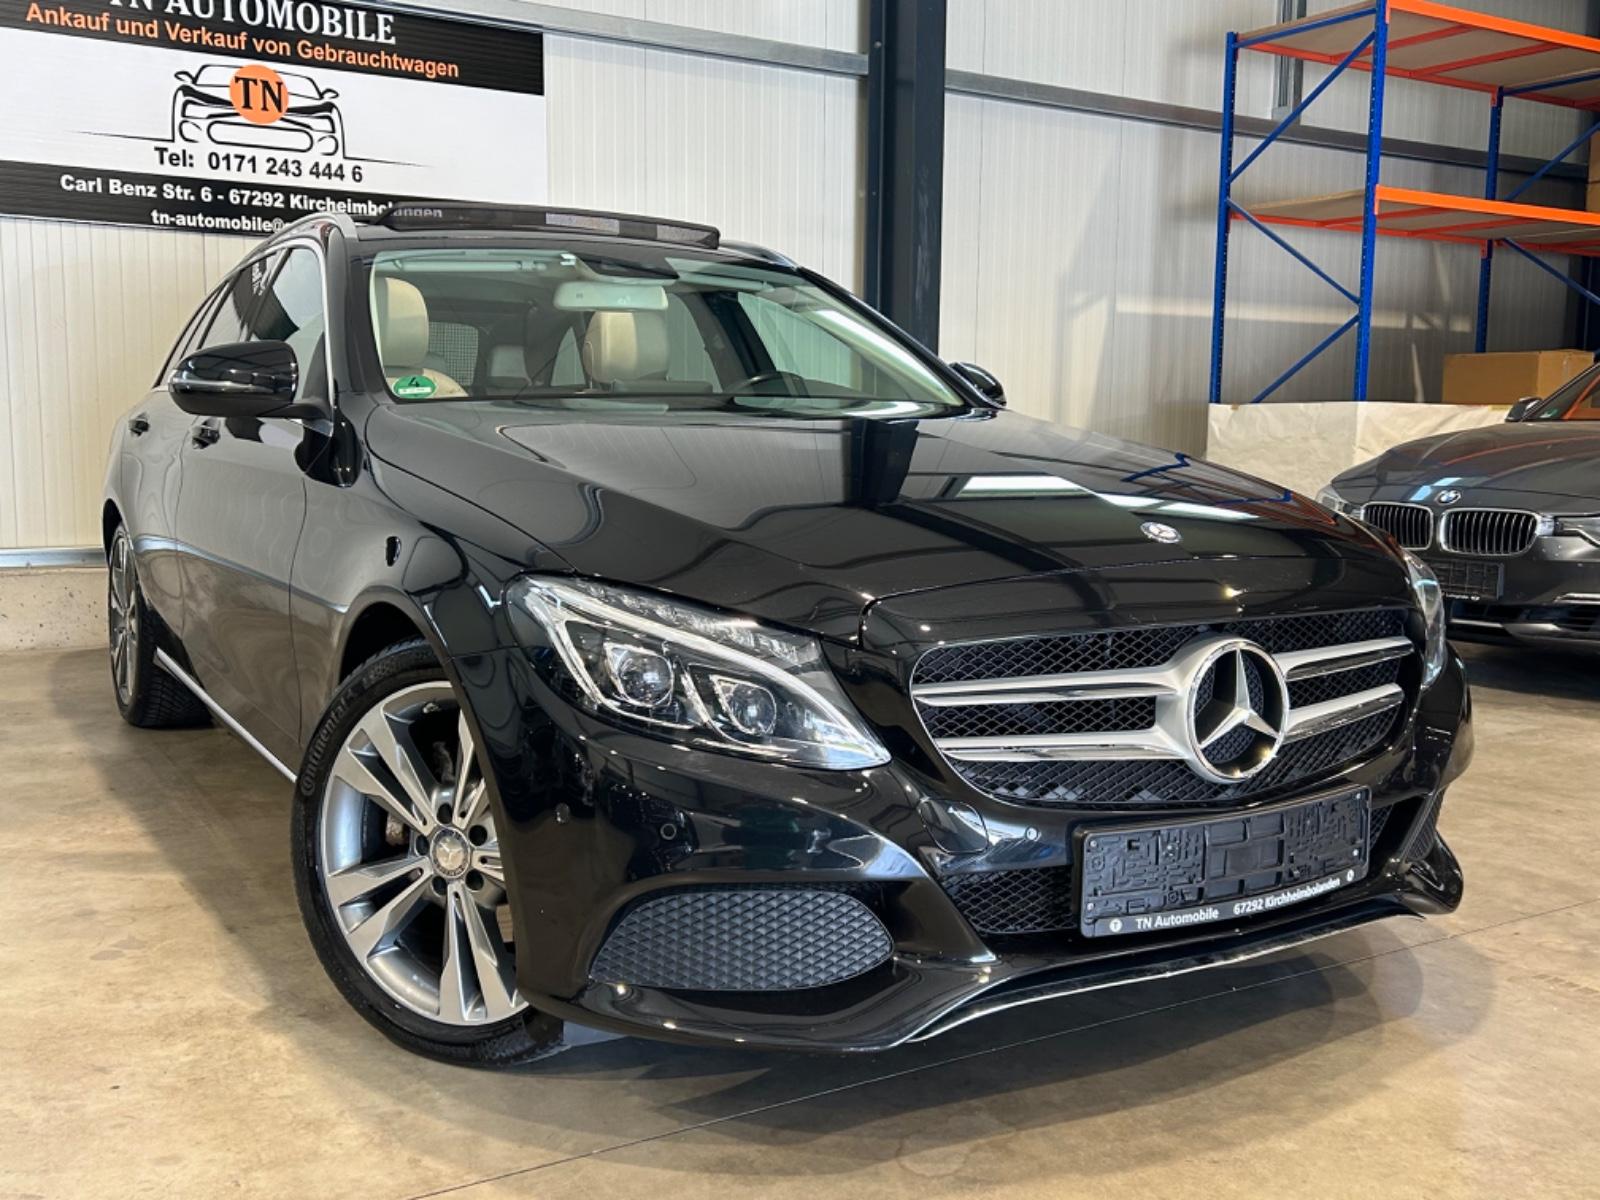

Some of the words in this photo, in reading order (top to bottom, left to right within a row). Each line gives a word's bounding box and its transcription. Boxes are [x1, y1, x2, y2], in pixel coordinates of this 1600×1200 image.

[26, 3, 110, 31] Ankauf
[116, 18, 158, 38] und
[164, 20, 248, 50] Verkauf
[252, 37, 291, 56] von
[297, 40, 459, 78] Gebrauchtwagen
[234, 76, 283, 113] TN
[154, 147, 194, 167] Tel:
[208, 152, 257, 173] 0171
[266, 157, 302, 177] 243
[309, 162, 345, 180] 444
[351, 165, 363, 183] 6
[60, 174, 102, 193] Carl
[109, 179, 157, 198] Benz
[162, 183, 195, 201] Str.
[201, 186, 212, 202] 6
[229, 189, 285, 208] 67292
[408, 377, 420, 387] 4
[1136, 917, 1152, 929] TN
[1154, 907, 1219, 928] Automobile
[1233, 898, 1264, 915] 67292
